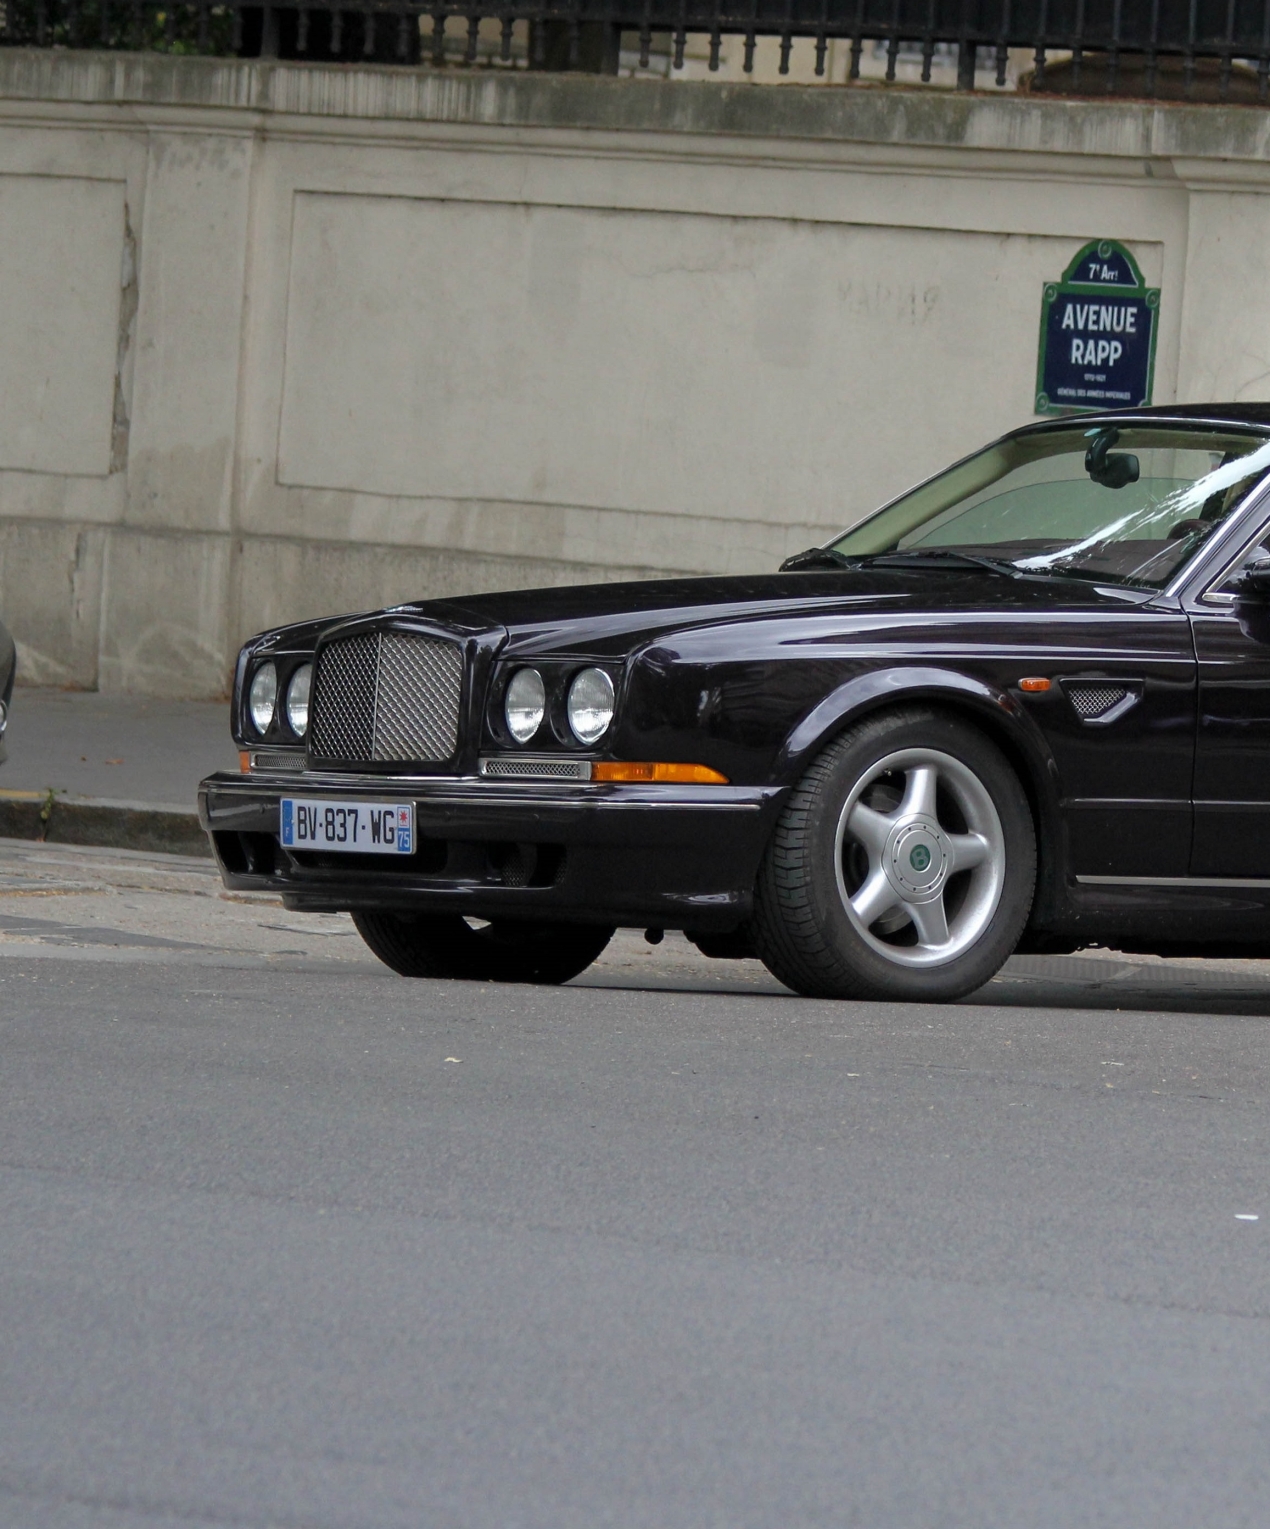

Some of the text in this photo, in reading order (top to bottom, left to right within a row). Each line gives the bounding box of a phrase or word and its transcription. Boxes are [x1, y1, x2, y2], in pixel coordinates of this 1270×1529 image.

[1061, 303, 1138, 333] AVENUE
[1071, 338, 1122, 367] RAPP
[398, 831, 410, 848] 75
